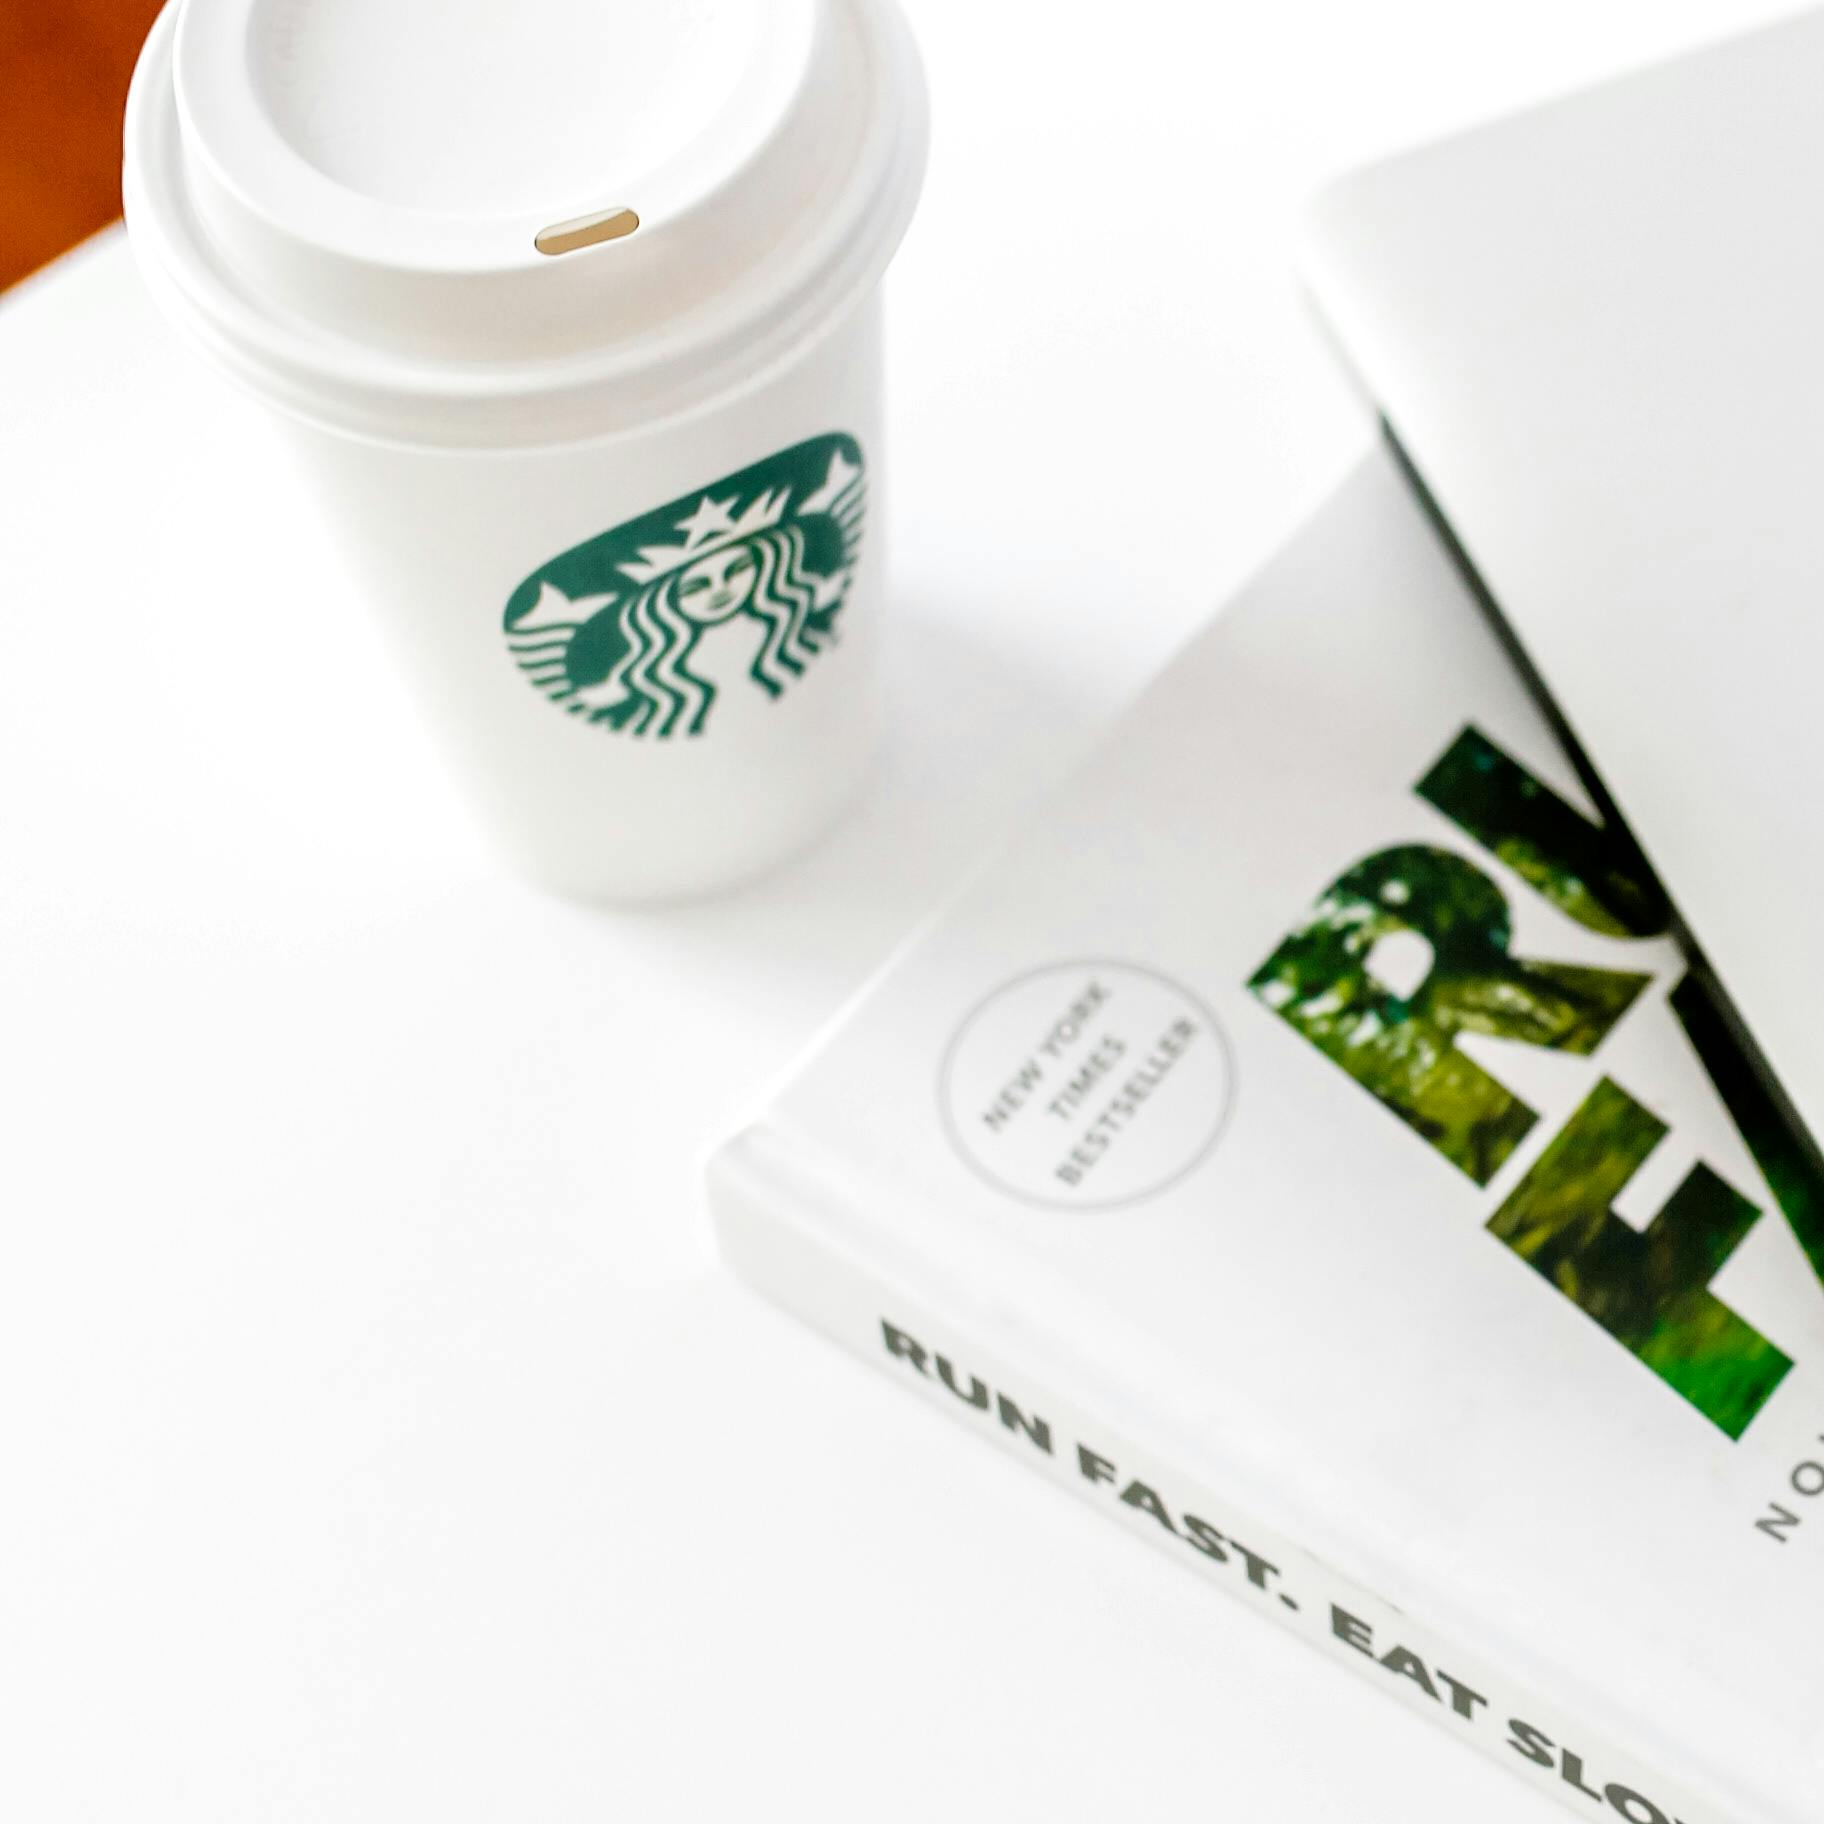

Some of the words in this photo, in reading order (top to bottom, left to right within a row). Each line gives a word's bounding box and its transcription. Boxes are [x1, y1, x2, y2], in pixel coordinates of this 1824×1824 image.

[981, 1055, 1043, 1132] NEW
[1041, 981, 1109, 1057] YORK
[1048, 1036, 1127, 1119] TIMES
[1055, 1017, 1197, 1186] BESTSELLER
[880, 1318, 1054, 1456] RUN
[1076, 1443, 1299, 1611] FAST.
[1330, 1603, 1488, 1720] EAT
